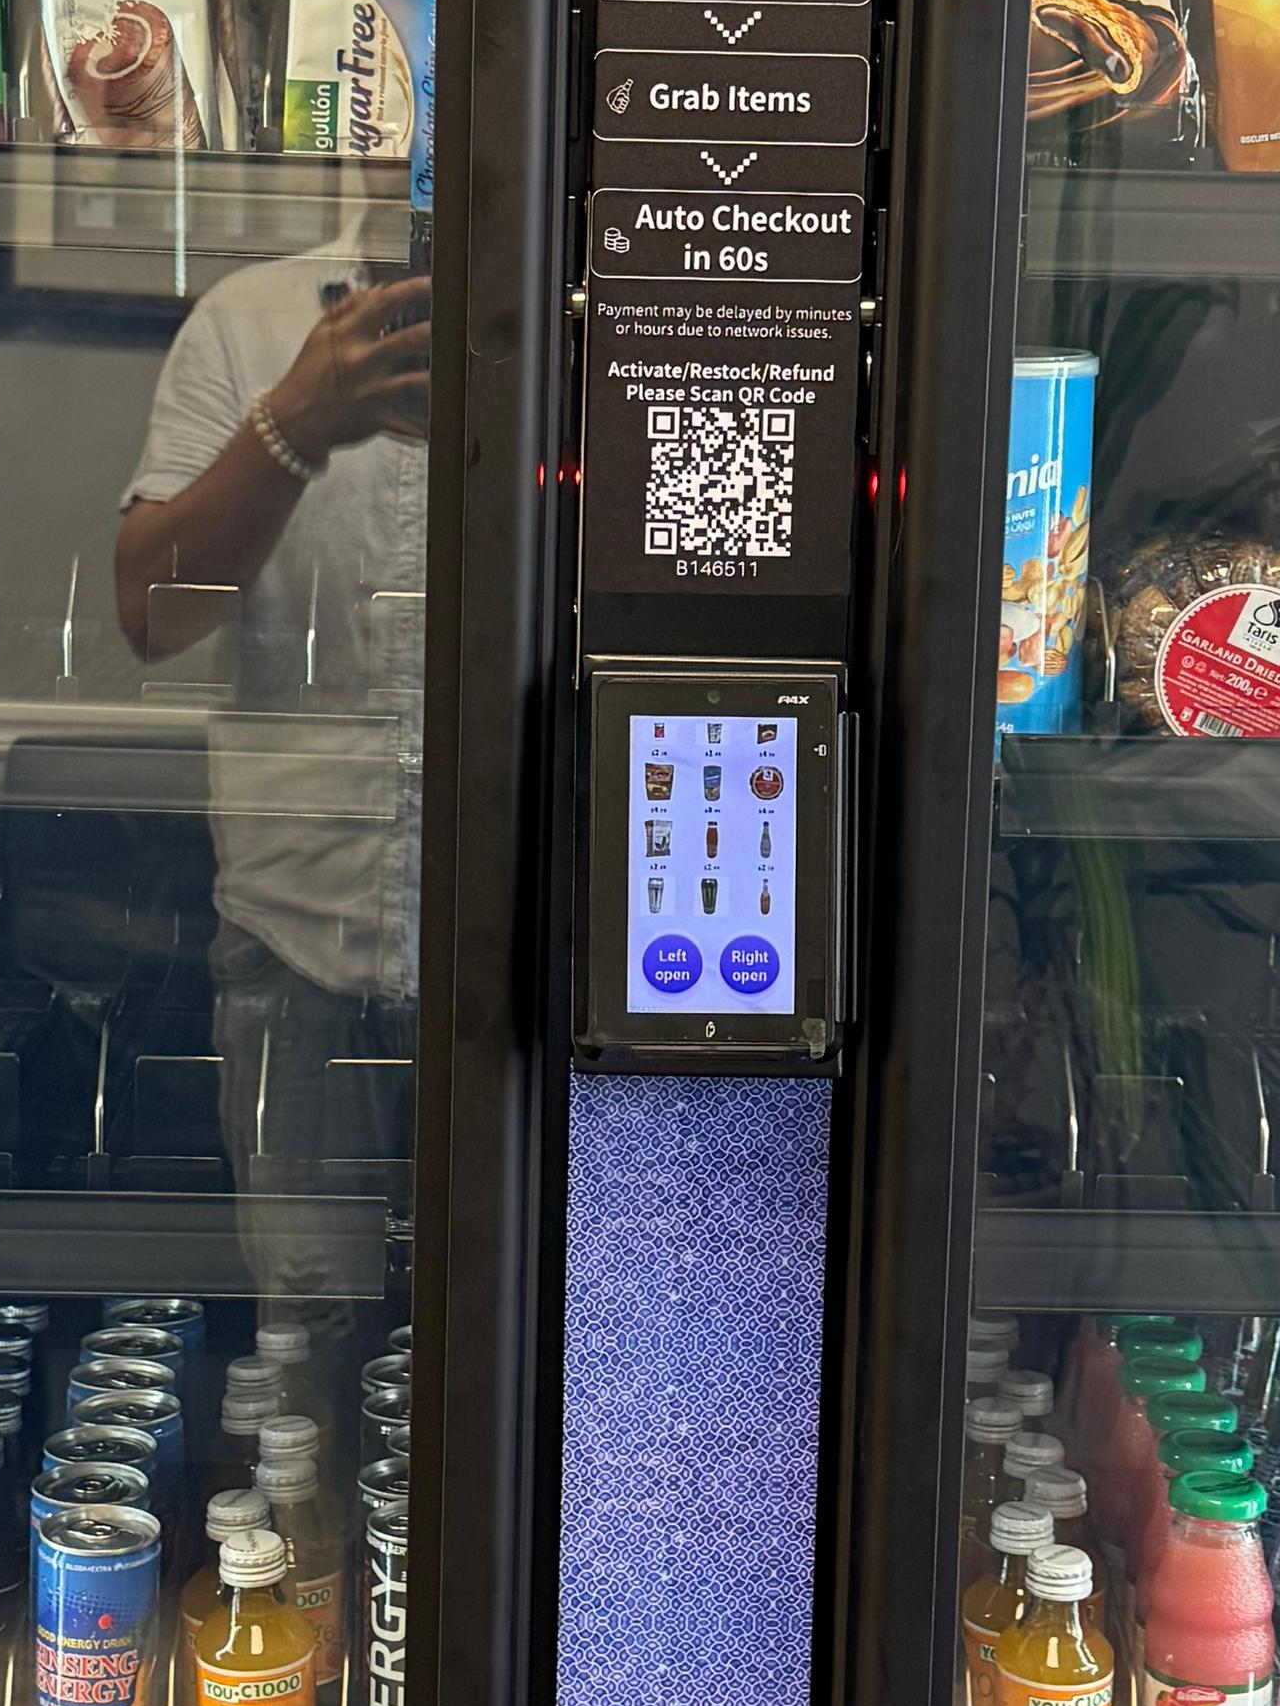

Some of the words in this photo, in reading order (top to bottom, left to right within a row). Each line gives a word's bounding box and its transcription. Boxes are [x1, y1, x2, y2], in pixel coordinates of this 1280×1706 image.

[650, 83, 719, 111] Grab
[729, 85, 811, 113] Items
[311, 84, 334, 149] gullón
[635, 204, 704, 231] Auto
[713, 205, 852, 235] Checkout
[684, 243, 710, 270] in
[720, 246, 768, 272] 60s
[597, 303, 659, 320] Payment
[663, 306, 693, 321] may
[696, 305, 713, 318] be
[717, 305, 771, 322] delayed
[775, 306, 792, 322] by
[796, 307, 852, 321] minutes
[616, 324, 631, 334] or
[635, 322, 674, 335] hours
[678, 323, 703, 336] due
[707, 325, 721, 337] to
[725, 325, 782, 338] network
[786, 325, 832, 339] issues.
[608, 361, 834, 382] Activate/Restock/Refund
[626, 384, 686, 401] Please
[690, 385, 733, 402] Scan
[738, 386, 764, 405] QR
[769, 388, 816, 404] Code
[1011, 508, 1035, 521] NUTS
[1181, 629, 1243, 665] GARLAND
[659, 950, 687, 963] Left
[731, 949, 769, 965] Right
[655, 970, 690, 983] open
[732, 971, 767, 984] open
